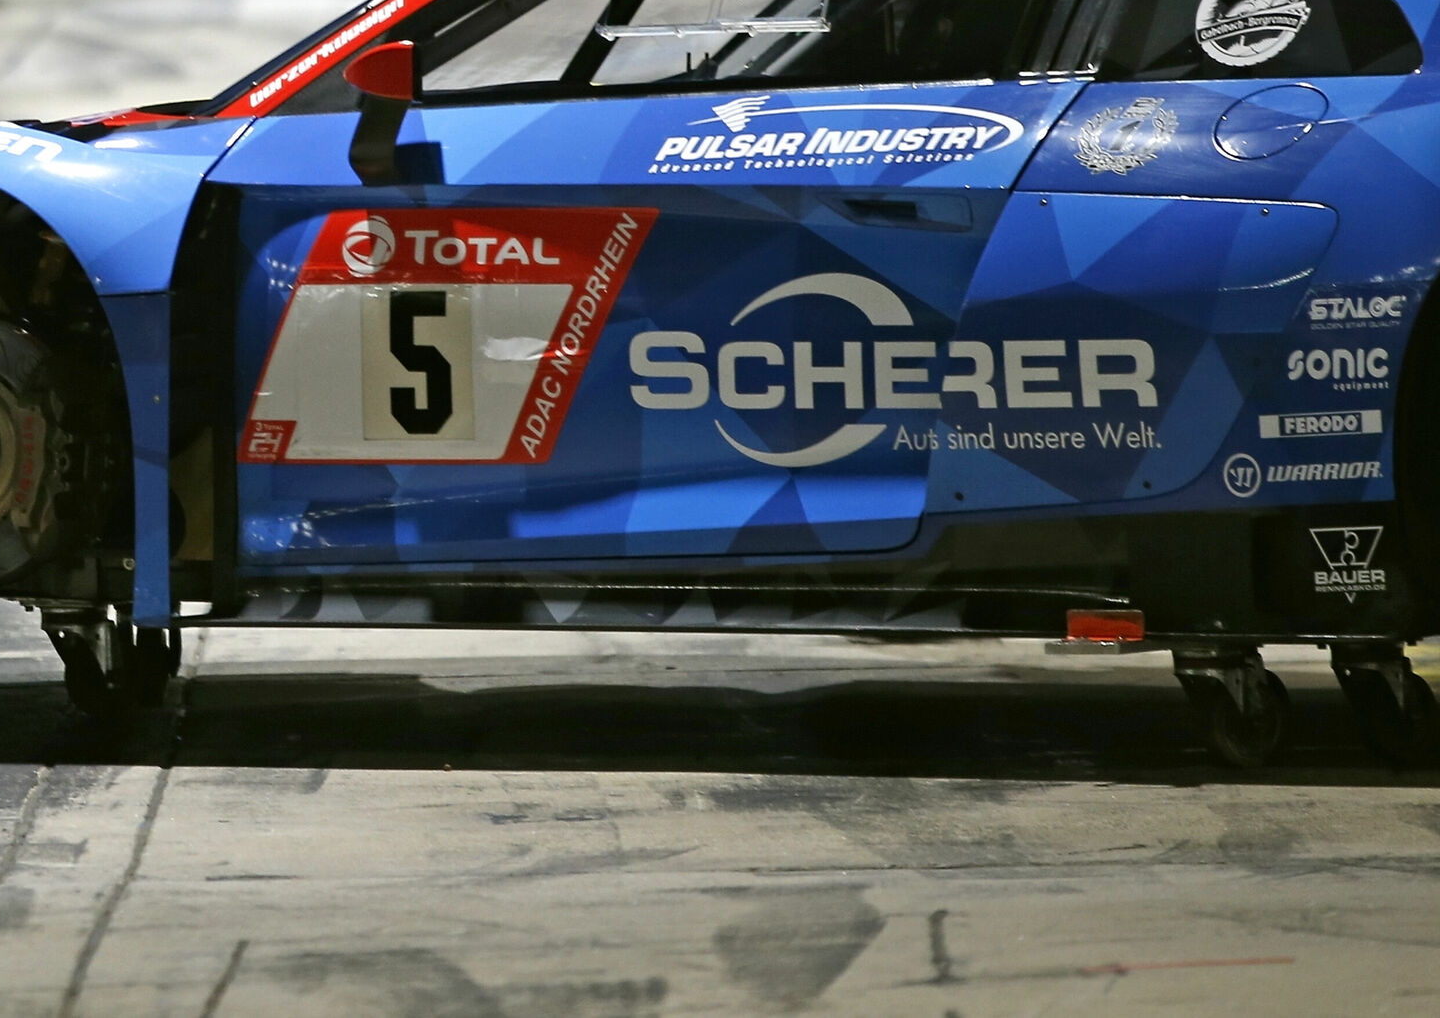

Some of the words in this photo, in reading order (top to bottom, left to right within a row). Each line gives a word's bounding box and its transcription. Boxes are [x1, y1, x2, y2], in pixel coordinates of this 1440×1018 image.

[655, 132, 808, 162] PULSAR
[803, 125, 1006, 156] INDUSTRY
[648, 160, 735, 174] Advanced
[743, 154, 875, 170] Technological
[883, 152, 976, 166] Solutions
[404, 229, 561, 266] TOTAL
[1309, 295, 1403, 320] STALOC
[517, 376, 561, 458] ADAC
[554, 211, 639, 376] NORDRHEIN
[389, 290, 454, 436] 5
[629, 330, 1158, 410] SCHERER
[1332, 382, 1389, 392] equipment
[947, 422, 995, 450] sind
[1003, 431, 1085, 450] unsere
[1092, 421, 1162, 450] Welt.
[1284, 414, 1359, 434] FERODO
[1314, 569, 1385, 585] BAUER
